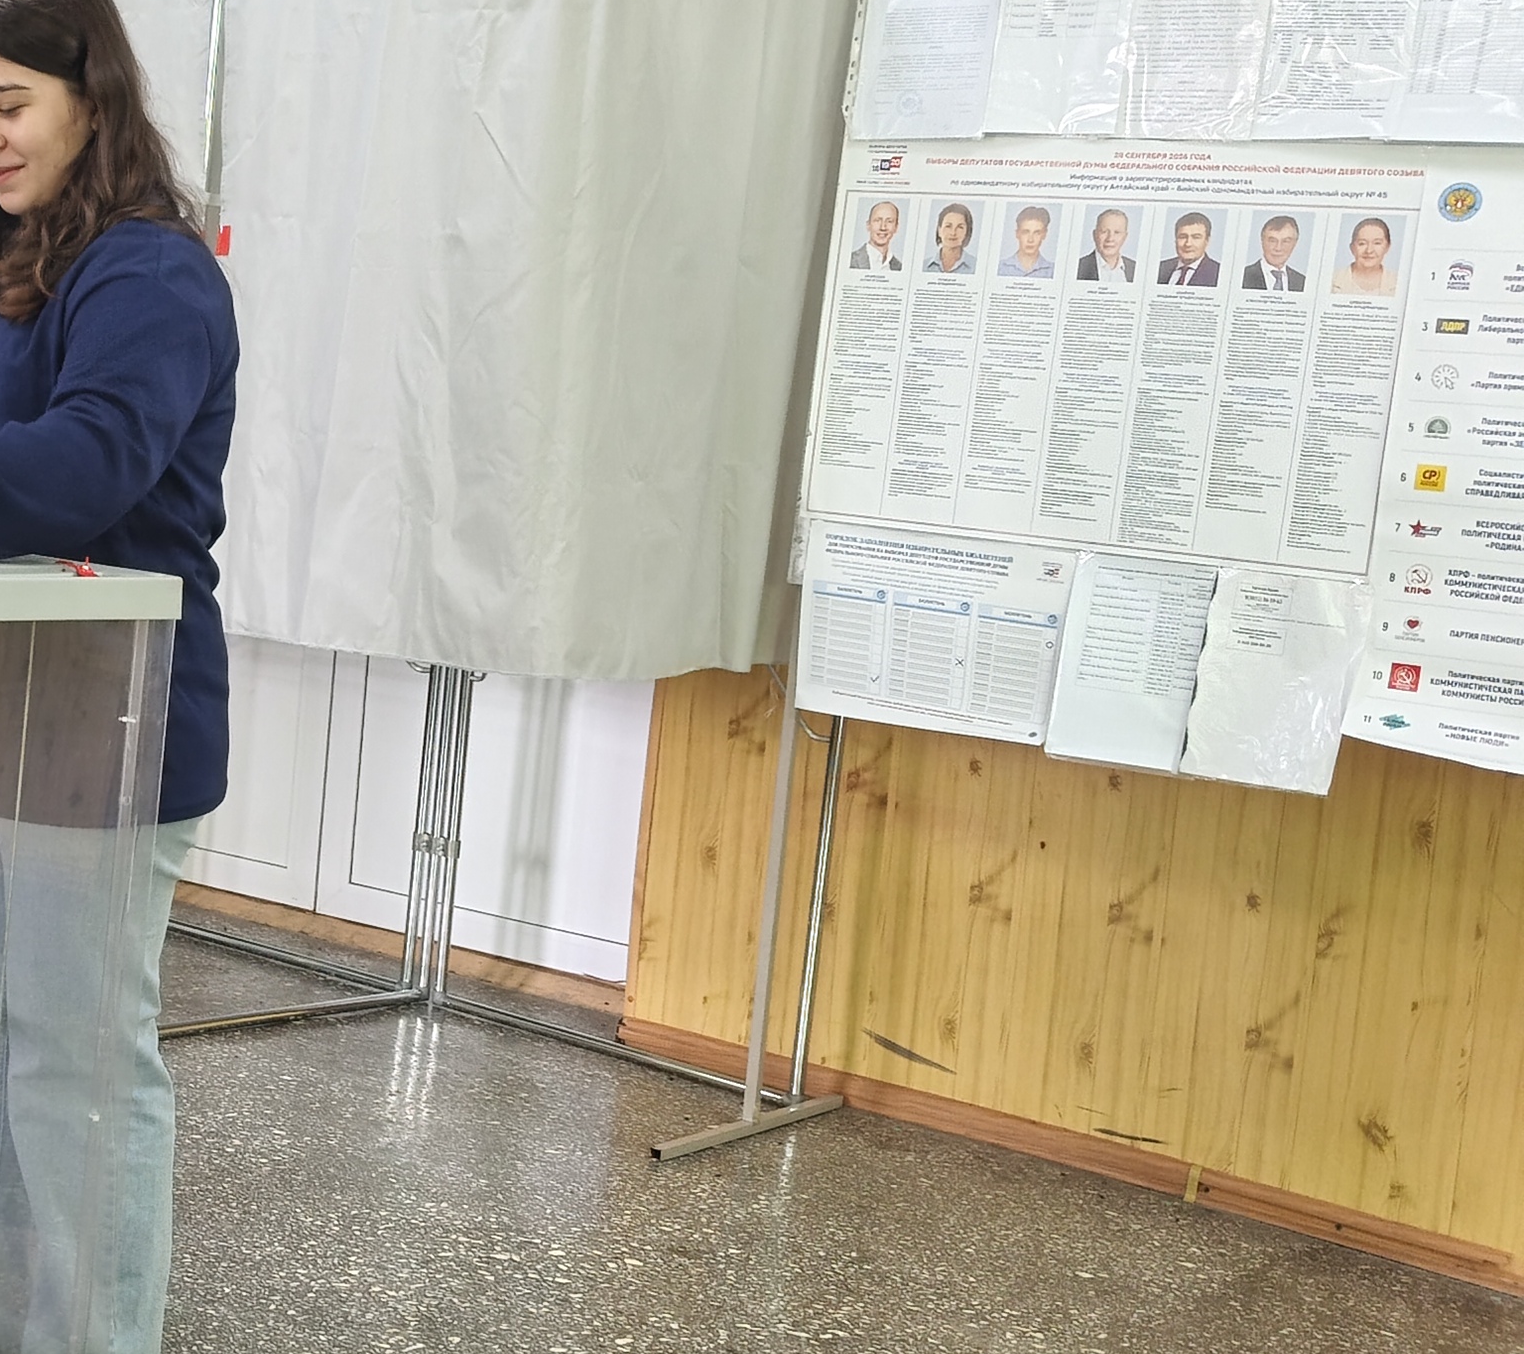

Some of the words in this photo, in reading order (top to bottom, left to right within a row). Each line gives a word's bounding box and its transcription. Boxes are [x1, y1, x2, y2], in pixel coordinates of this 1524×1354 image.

[959, 158, 1004, 167] ДЕПУТАТОВ
[1431, 272, 1436, 281] 1
[1421, 321, 1429, 332] 3
[1408, 422, 1415, 432] 5
[1400, 472, 1407, 482] 6
[1394, 522, 1401, 532] 7
[1461, 529, 1522, 541] ПОЛИТИЧЕСКАЯ
[1389, 572, 1396, 582] 8
[1403, 585, 1432, 595] КПРФ
[1449, 589, 1500, 601] РОССИЙСКОЙ
[1381, 621, 1389, 632] 9
[1449, 630, 1479, 640] ПАРТИЯ
[1372, 670, 1383, 681] 10
[1430, 678, 1513, 695] КОММУНИСТИЧЕСКАЯ
[1441, 689, 1497, 703] КОММУНИСТЫ
[1363, 715, 1372, 723] 11
